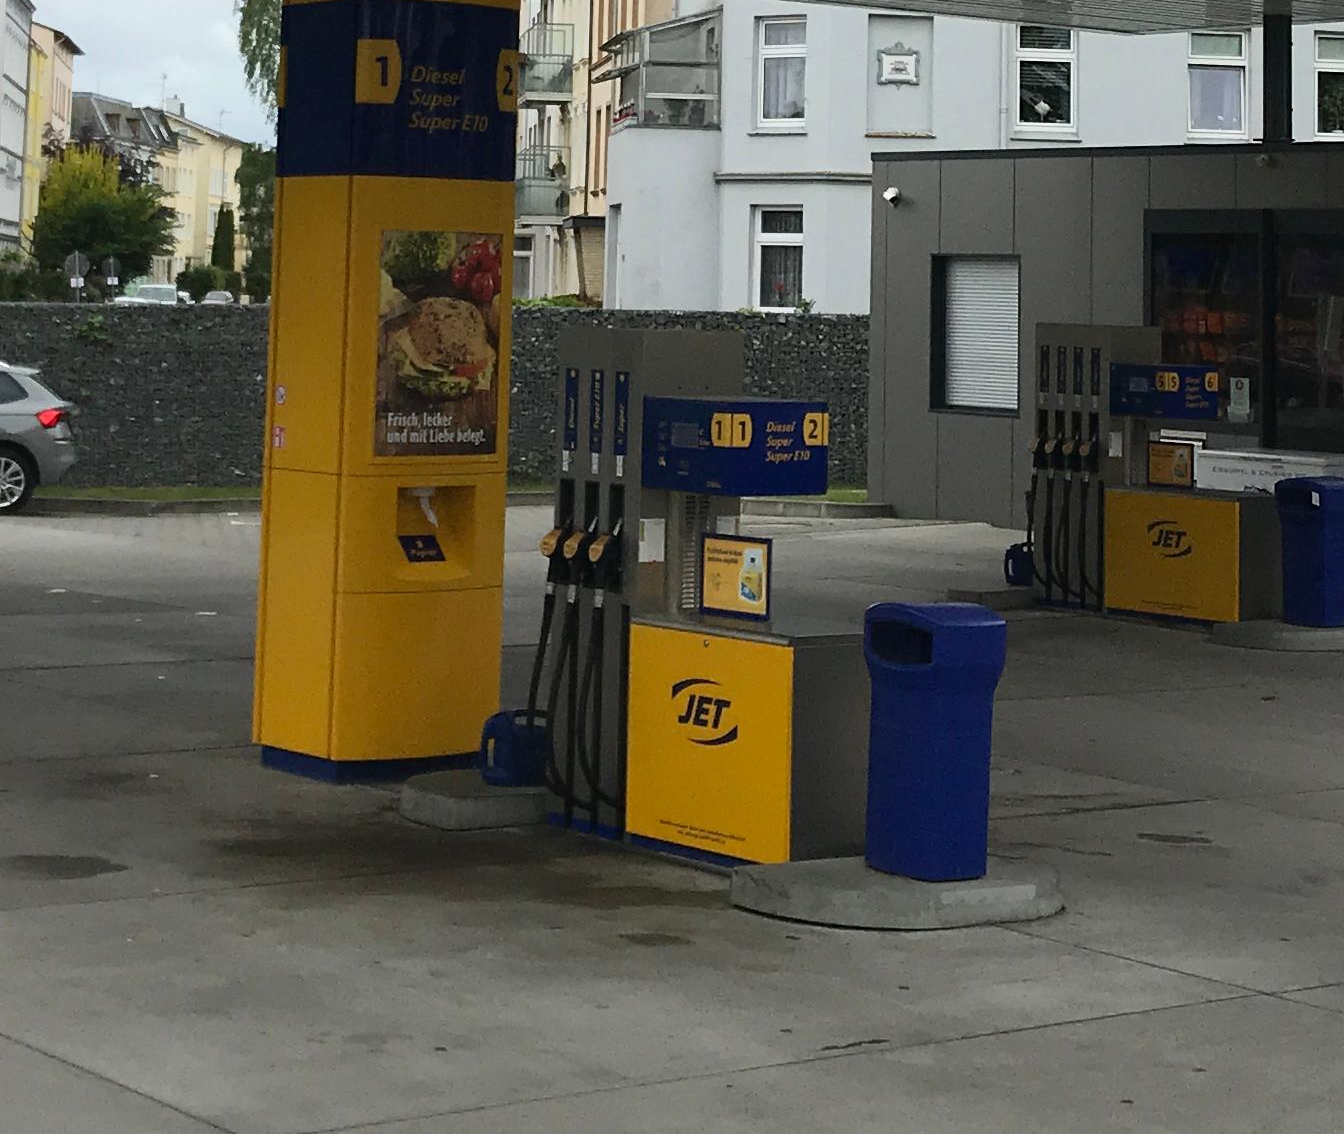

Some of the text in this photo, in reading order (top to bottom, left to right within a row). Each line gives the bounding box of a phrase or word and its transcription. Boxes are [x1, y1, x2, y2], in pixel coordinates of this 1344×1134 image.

[375, 55, 389, 87] 1
[410, 66, 467, 85] Diesel
[503, 65, 514, 96] 2
[409, 88, 461, 111] Super
[408, 111, 489, 134] Super E10
[387, 412, 454, 429] Frisch, lecker
[714, 420, 723, 441] 1
[738, 420, 747, 442] 1
[766, 421, 796, 433] Diesel
[808, 419, 819, 440] 2
[387, 429, 487, 446] und mit Liebe belegt.
[766, 436, 794, 450] Super
[765, 450, 811, 465] Super E10
[1152, 529, 1187, 549] JET
[678, 693, 732, 730] JET
